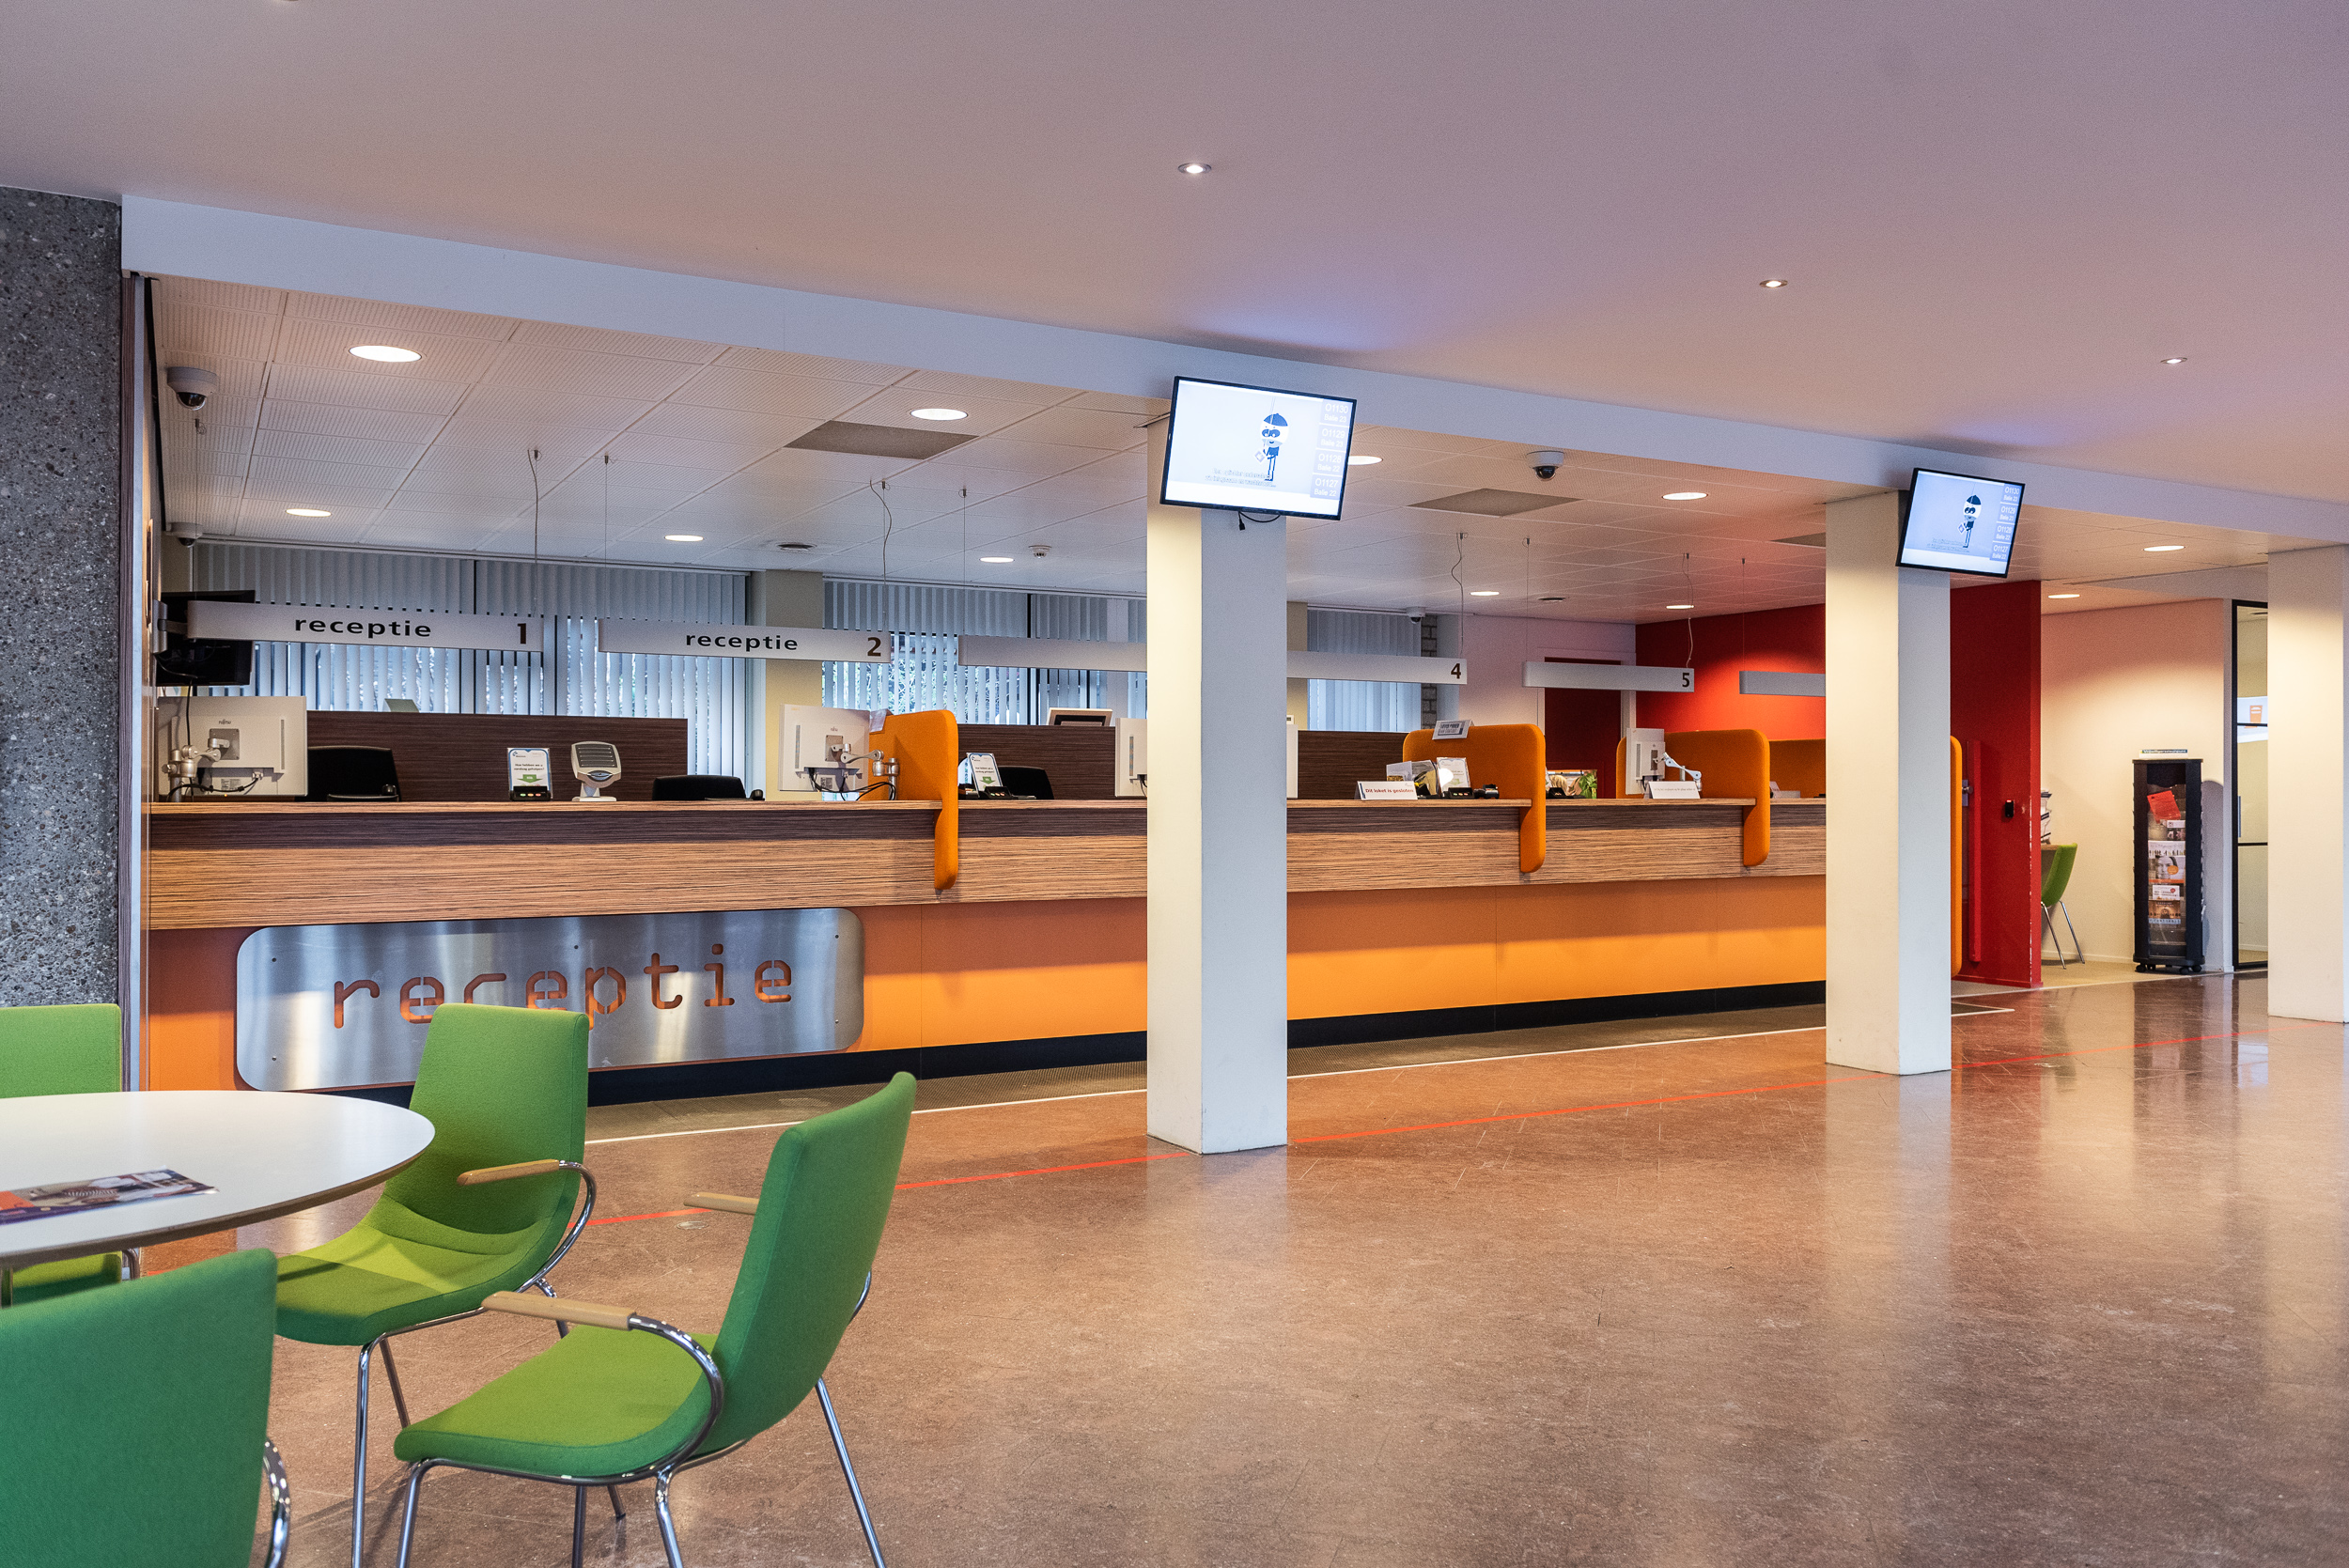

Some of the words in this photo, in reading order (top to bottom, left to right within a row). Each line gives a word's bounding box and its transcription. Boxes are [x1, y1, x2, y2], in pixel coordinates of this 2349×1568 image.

[1324, 413, 1338, 422] Balie
[295, 618, 431, 639] receptie
[518, 622, 527, 644] 1
[686, 634, 798, 652] receptie
[866, 637, 881, 657] 2
[1451, 662, 1462, 679] 4
[1682, 672, 1690, 688] 5
